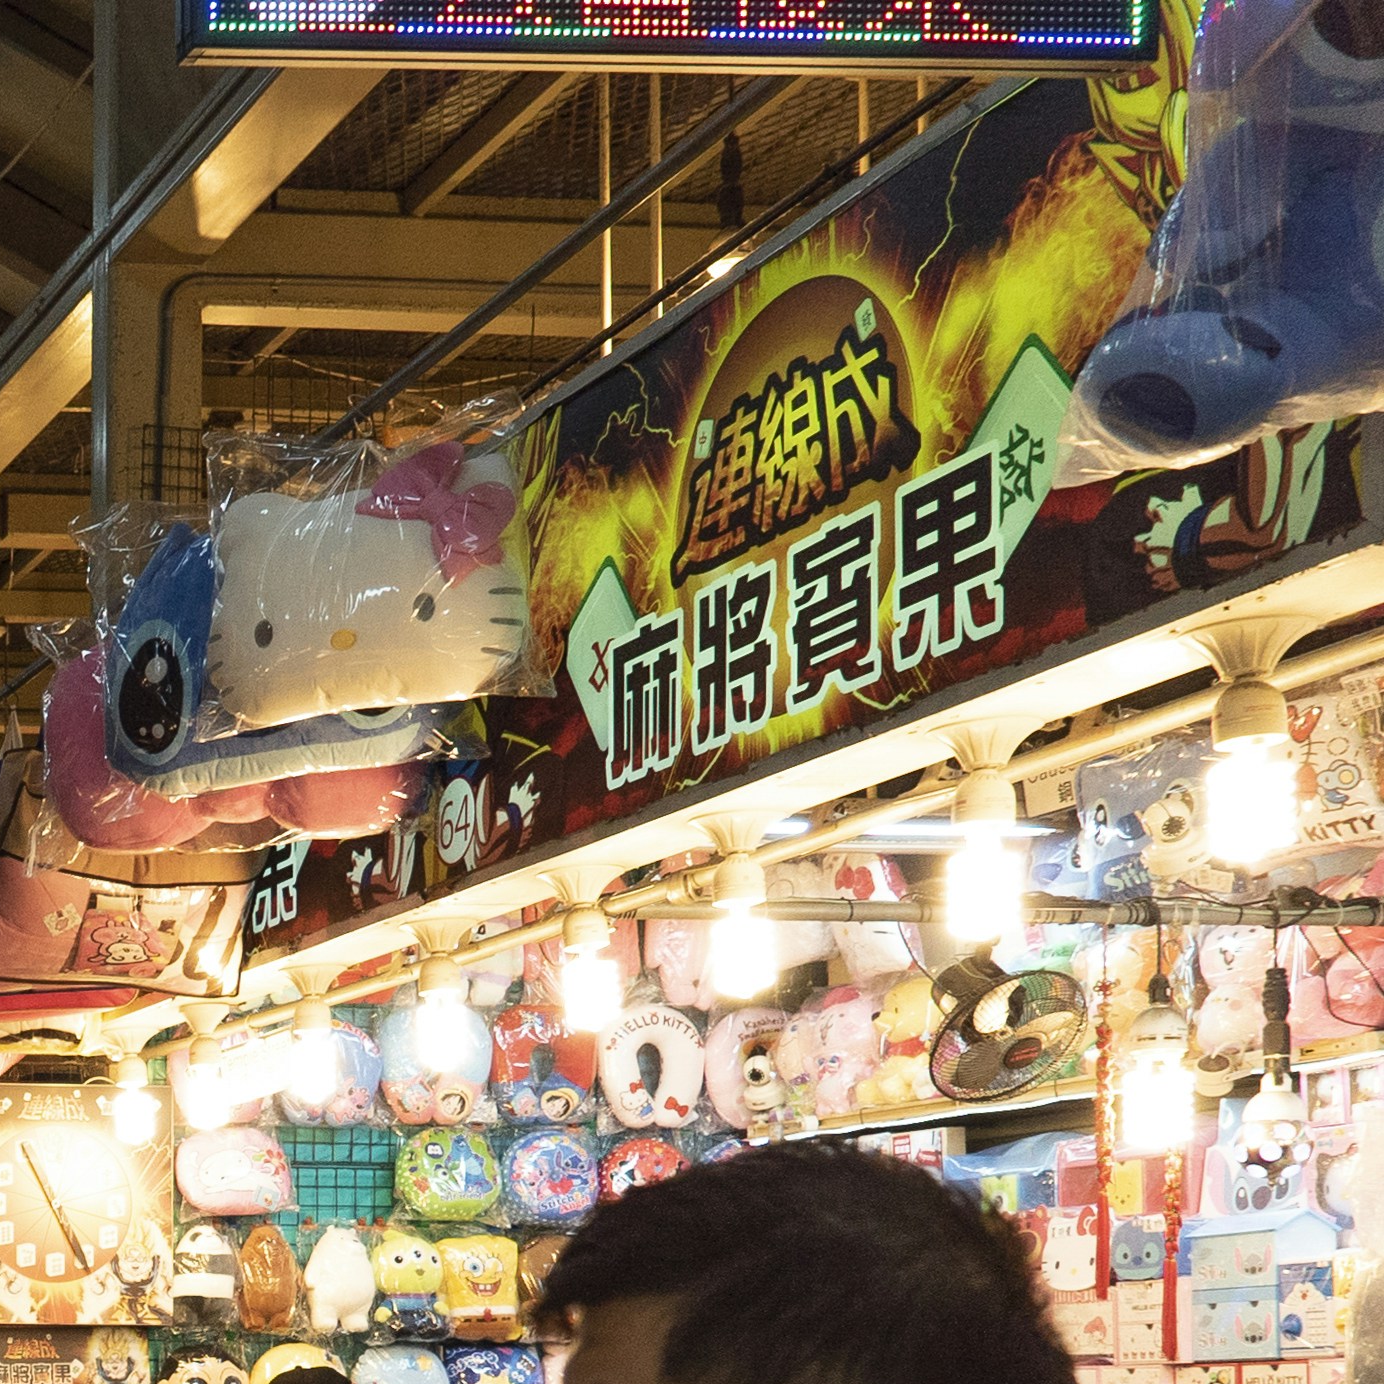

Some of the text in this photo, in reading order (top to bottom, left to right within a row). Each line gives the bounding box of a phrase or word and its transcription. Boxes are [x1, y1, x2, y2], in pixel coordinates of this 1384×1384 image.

[675, 343, 896, 582] 連線成
[606, 440, 1005, 790] 麻將賓果
[440, 795, 470, 849] 64
